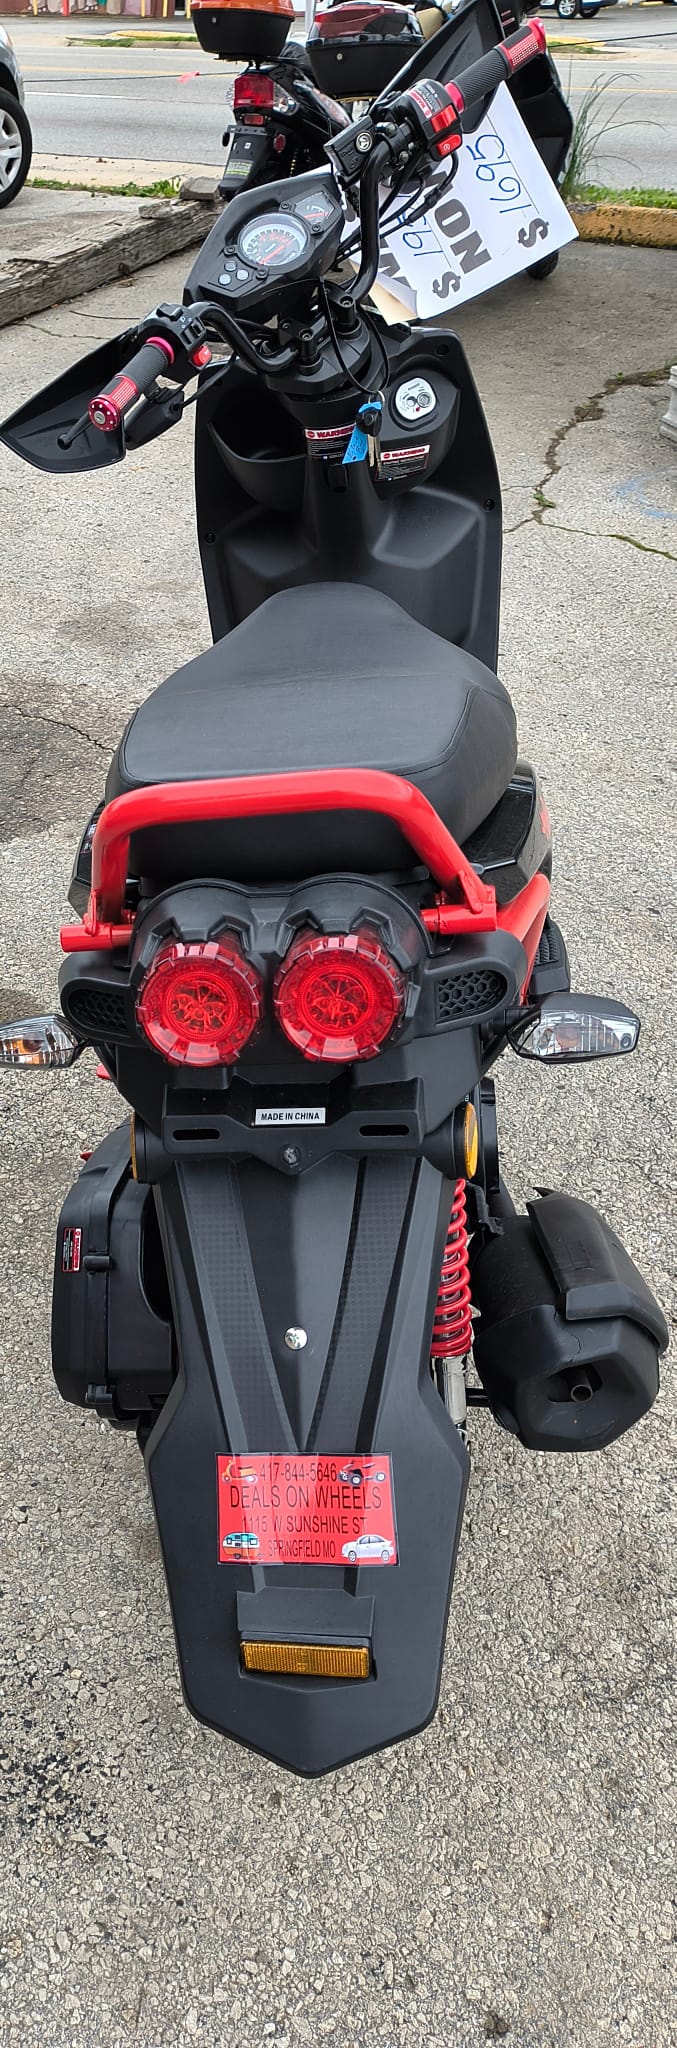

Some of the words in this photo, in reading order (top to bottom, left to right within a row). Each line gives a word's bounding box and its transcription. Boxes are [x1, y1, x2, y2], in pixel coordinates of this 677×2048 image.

[466, 134, 533, 214] 1695
[517, 217, 550, 248] $
[432, 271, 462, 299] $
[261, 1112, 284, 1121] MADE
[285, 1112, 293, 1120] IN
[294, 1112, 320, 1120] CHINA
[260, 1462, 337, 1482] 417-844-5646
[230, 1485, 281, 1508] DEALS
[286, 1486, 309, 1508] ON
[315, 1486, 382, 1509] WHEELS
[242, 1516, 268, 1533] 1115
[273, 1516, 282, 1532] W
[286, 1516, 349, 1534] SUNSHINE
[352, 1516, 367, 1534] ST
[268, 1539, 321, 1558] SPRINGFIELD
[323, 1540, 336, 1558] MO
